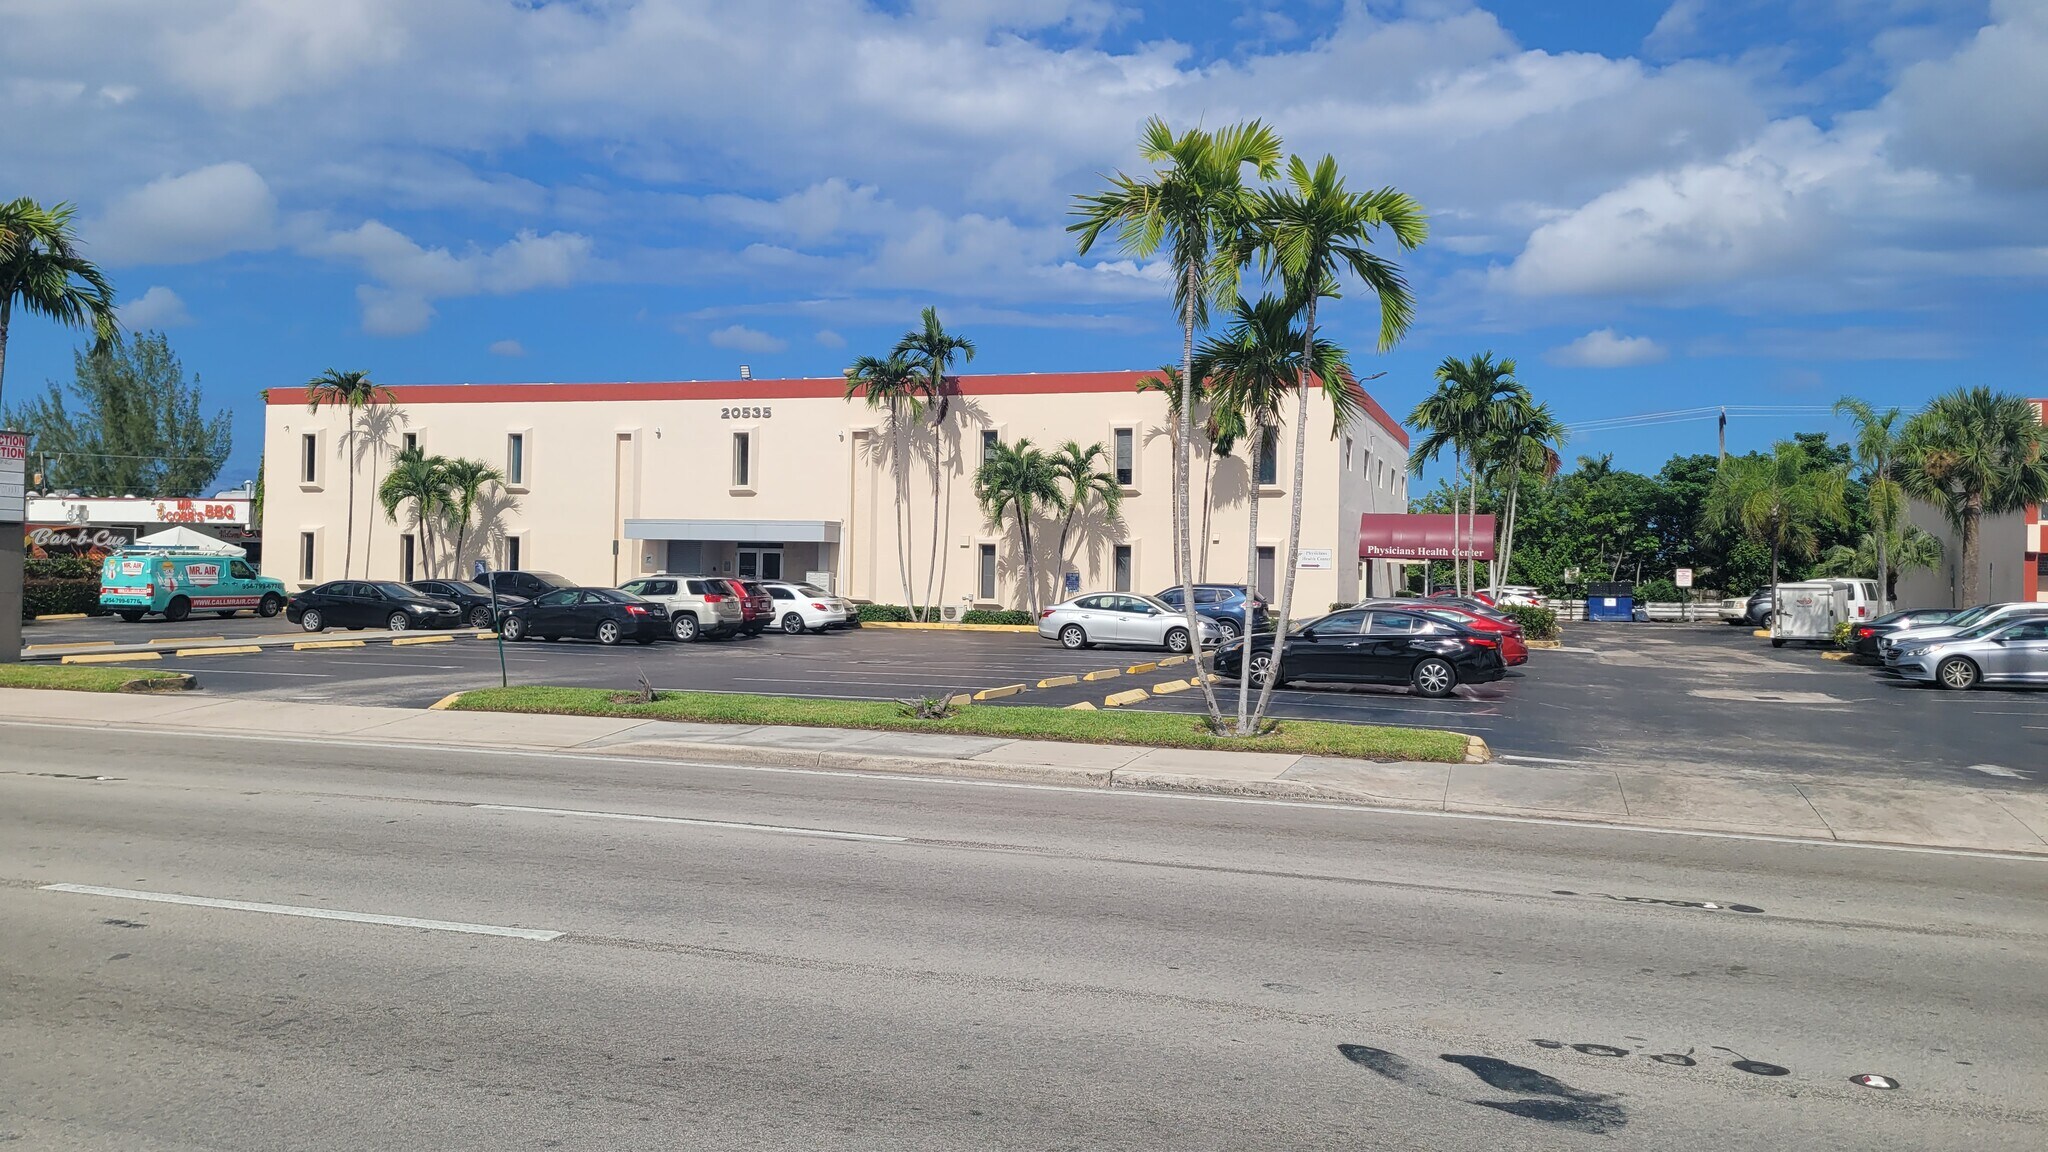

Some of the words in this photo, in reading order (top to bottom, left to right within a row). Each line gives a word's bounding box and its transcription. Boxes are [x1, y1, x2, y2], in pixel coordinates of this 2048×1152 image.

[720, 406, 772, 420] 20535
[205, 504, 236, 520] BBQ
[1367, 545, 1415, 556] Physicians
[1417, 547, 1448, 556] Health
[1452, 548, 1484, 557] Center
[188, 566, 203, 575] MR.
[204, 566, 217, 575] AIR
[193, 598, 260, 606] WWW.CALLMRAIR.COM
